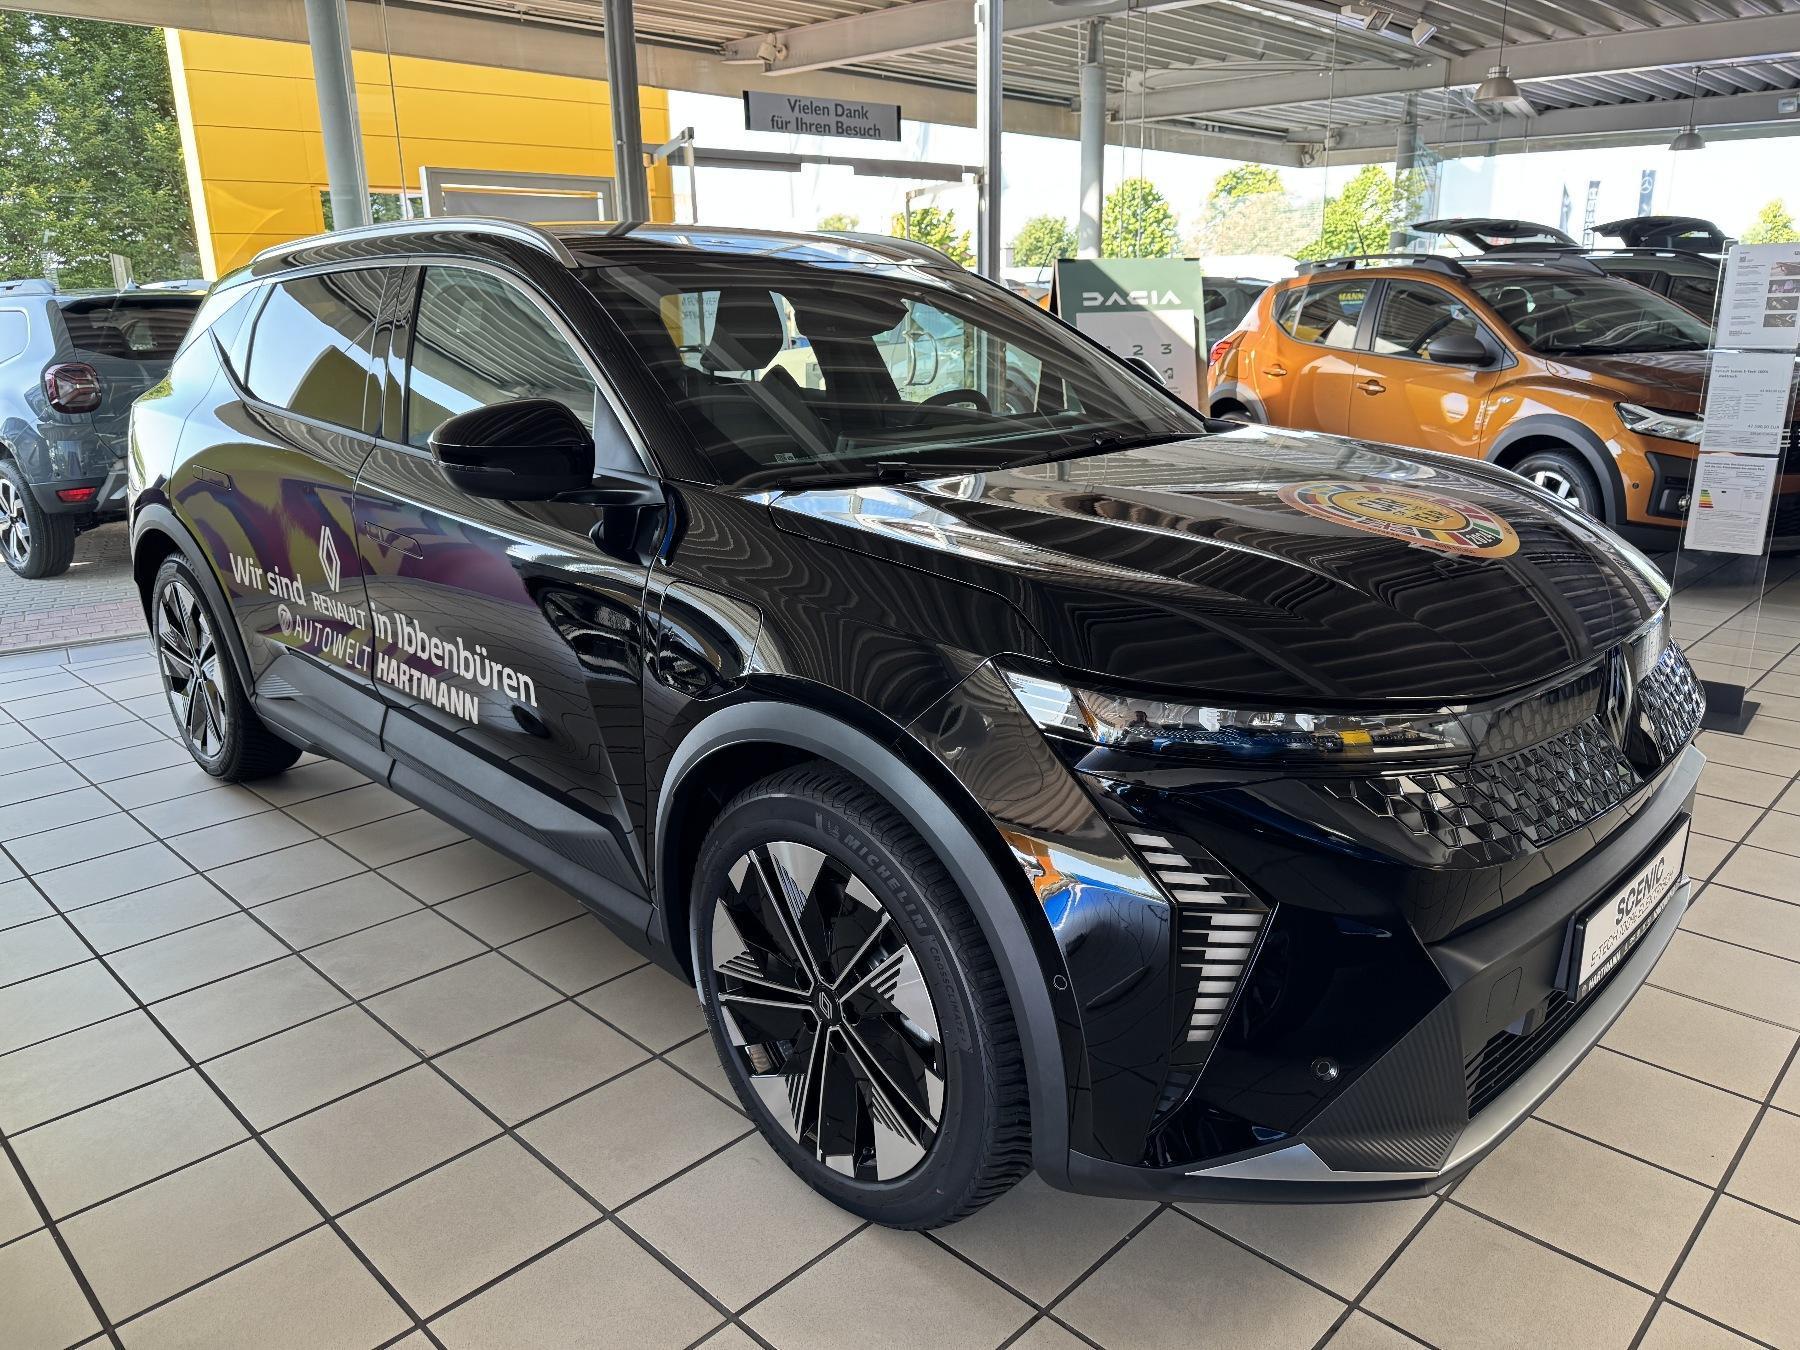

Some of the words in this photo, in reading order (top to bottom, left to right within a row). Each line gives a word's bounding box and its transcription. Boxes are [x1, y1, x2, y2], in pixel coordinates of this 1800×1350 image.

[787, 98, 830, 116] Vielen
[835, 103, 869, 120] Dank
[770, 115, 791, 130] für
[795, 117, 831, 134] Ihren
[836, 120, 881, 138] Besuch
[1082, 290, 1182, 307] DACIA
[1132, 345, 1144, 356] 2
[1161, 343, 1172, 355] 3
[1466, 531, 1496, 545] 2024
[229, 553, 263, 590] Wir
[269, 567, 305, 606] sind
[311, 591, 366, 631] RENAULT
[371, 602, 393, 643] in
[397, 612, 538, 708] Ibbenbüren
[293, 614, 372, 672] AUTOWELT
[377, 652, 480, 725] HARTMANN
[843, 833, 928, 930] MICHELIN
[1615, 856, 1665, 926] SCENIC
